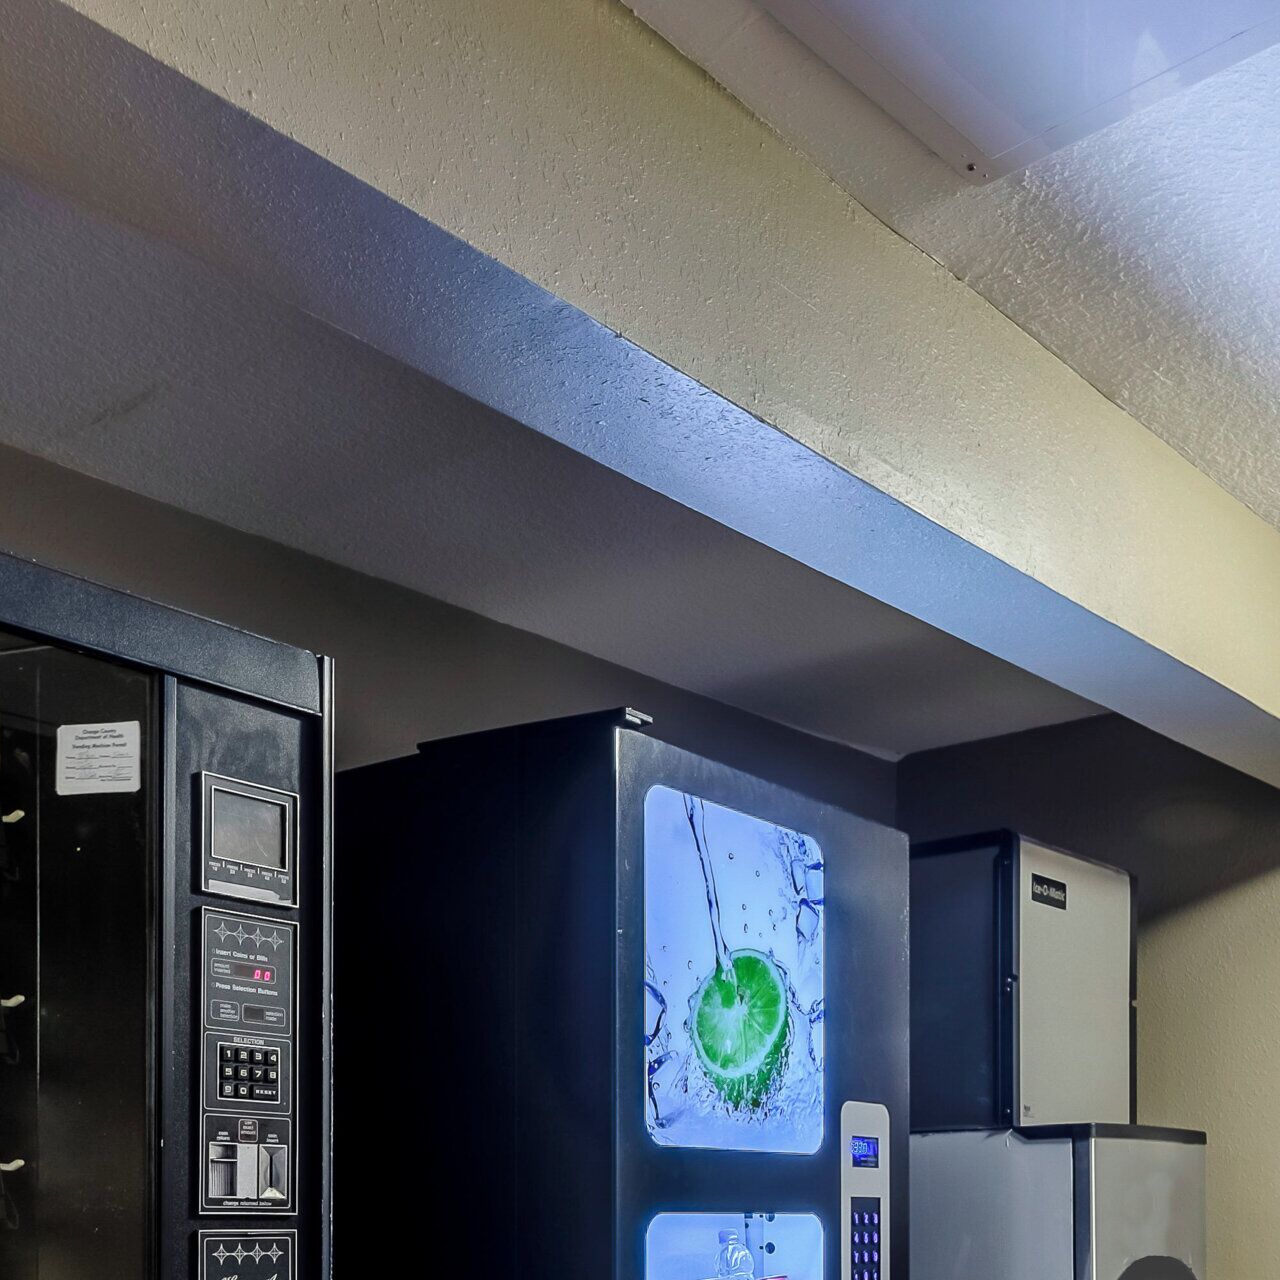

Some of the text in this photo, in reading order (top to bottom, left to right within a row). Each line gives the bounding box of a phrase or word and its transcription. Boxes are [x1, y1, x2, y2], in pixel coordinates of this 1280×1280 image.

[233, 1036, 265, 1046] SELECTION
[226, 1050, 232, 1058] 1
[240, 1051, 248, 1060] 2
[255, 1052, 262, 1060] 3
[270, 1054, 277, 1062] 4
[225, 1068, 233, 1076] 5
[240, 1069, 248, 1077] 6
[255, 1070, 262, 1079] 7
[270, 1071, 277, 1079] 8
[225, 1085, 233, 1093] 9
[240, 1087, 248, 1095] 0
